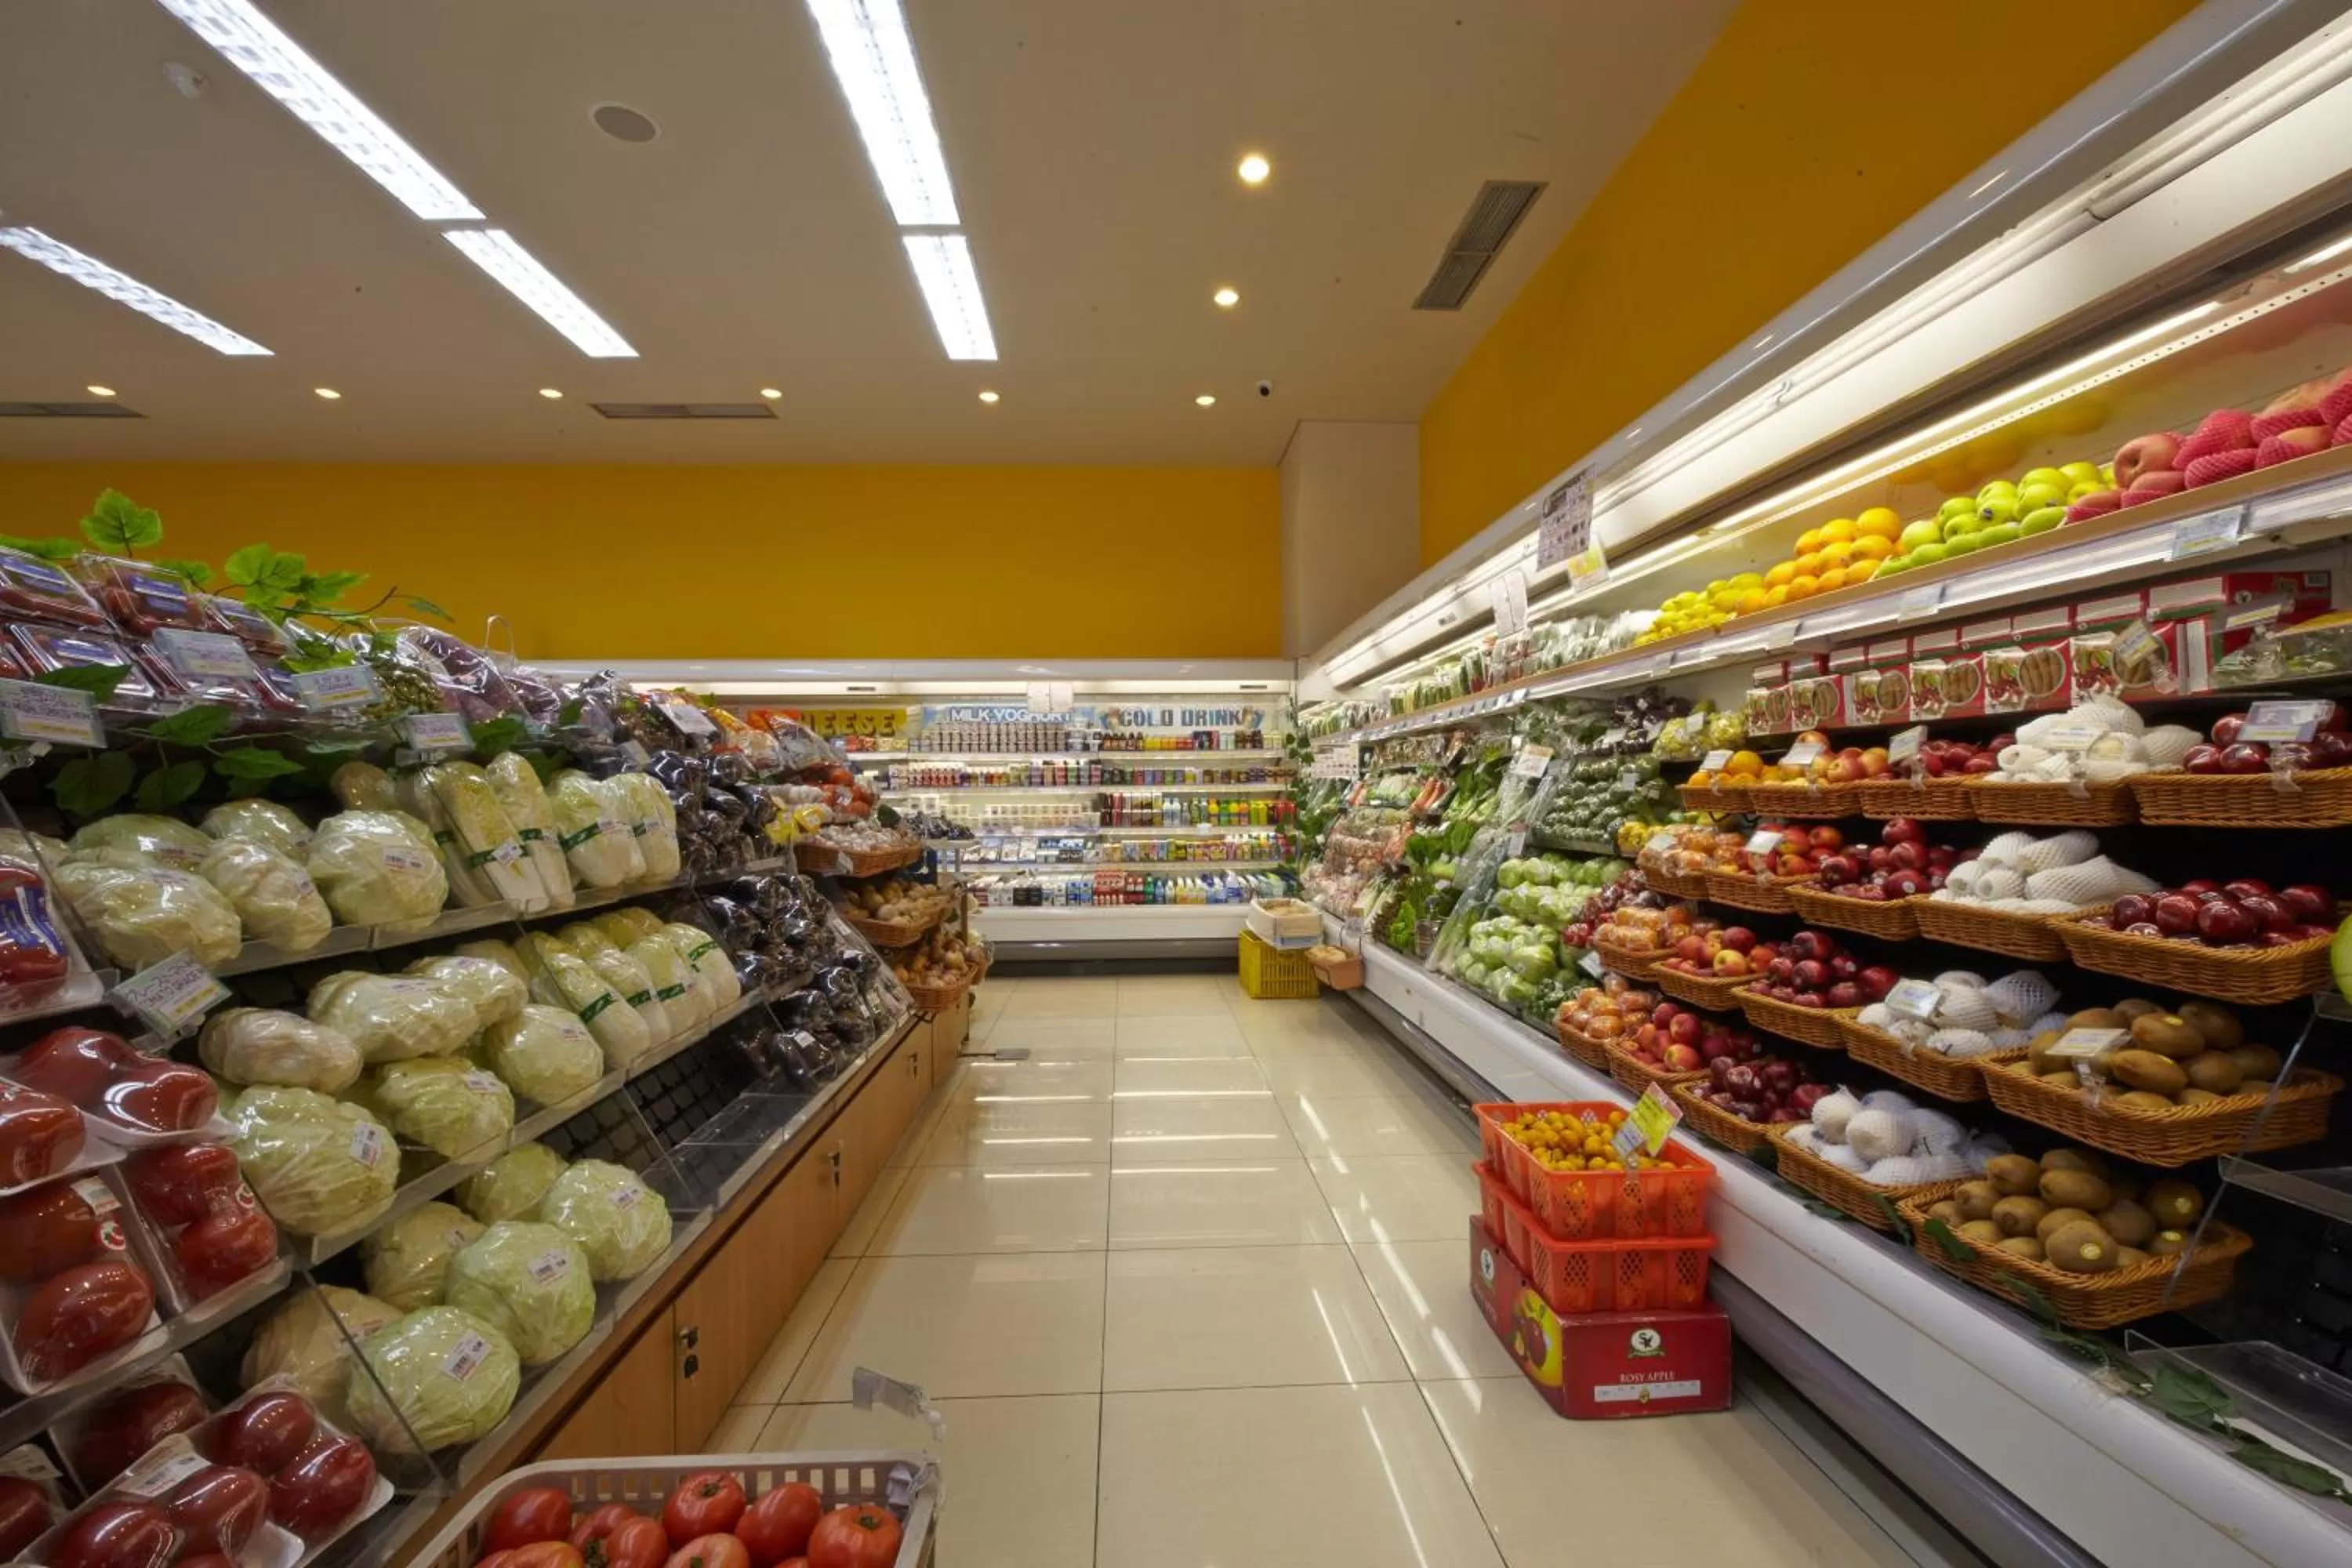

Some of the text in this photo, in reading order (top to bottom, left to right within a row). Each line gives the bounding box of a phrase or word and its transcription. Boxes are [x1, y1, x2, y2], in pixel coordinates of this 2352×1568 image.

[951, 708, 990, 722] MILK
[1120, 709, 1174, 727] COLD
[800, 712, 895, 735] HEESE
[1647, 1370, 1676, 1381] APPLE
